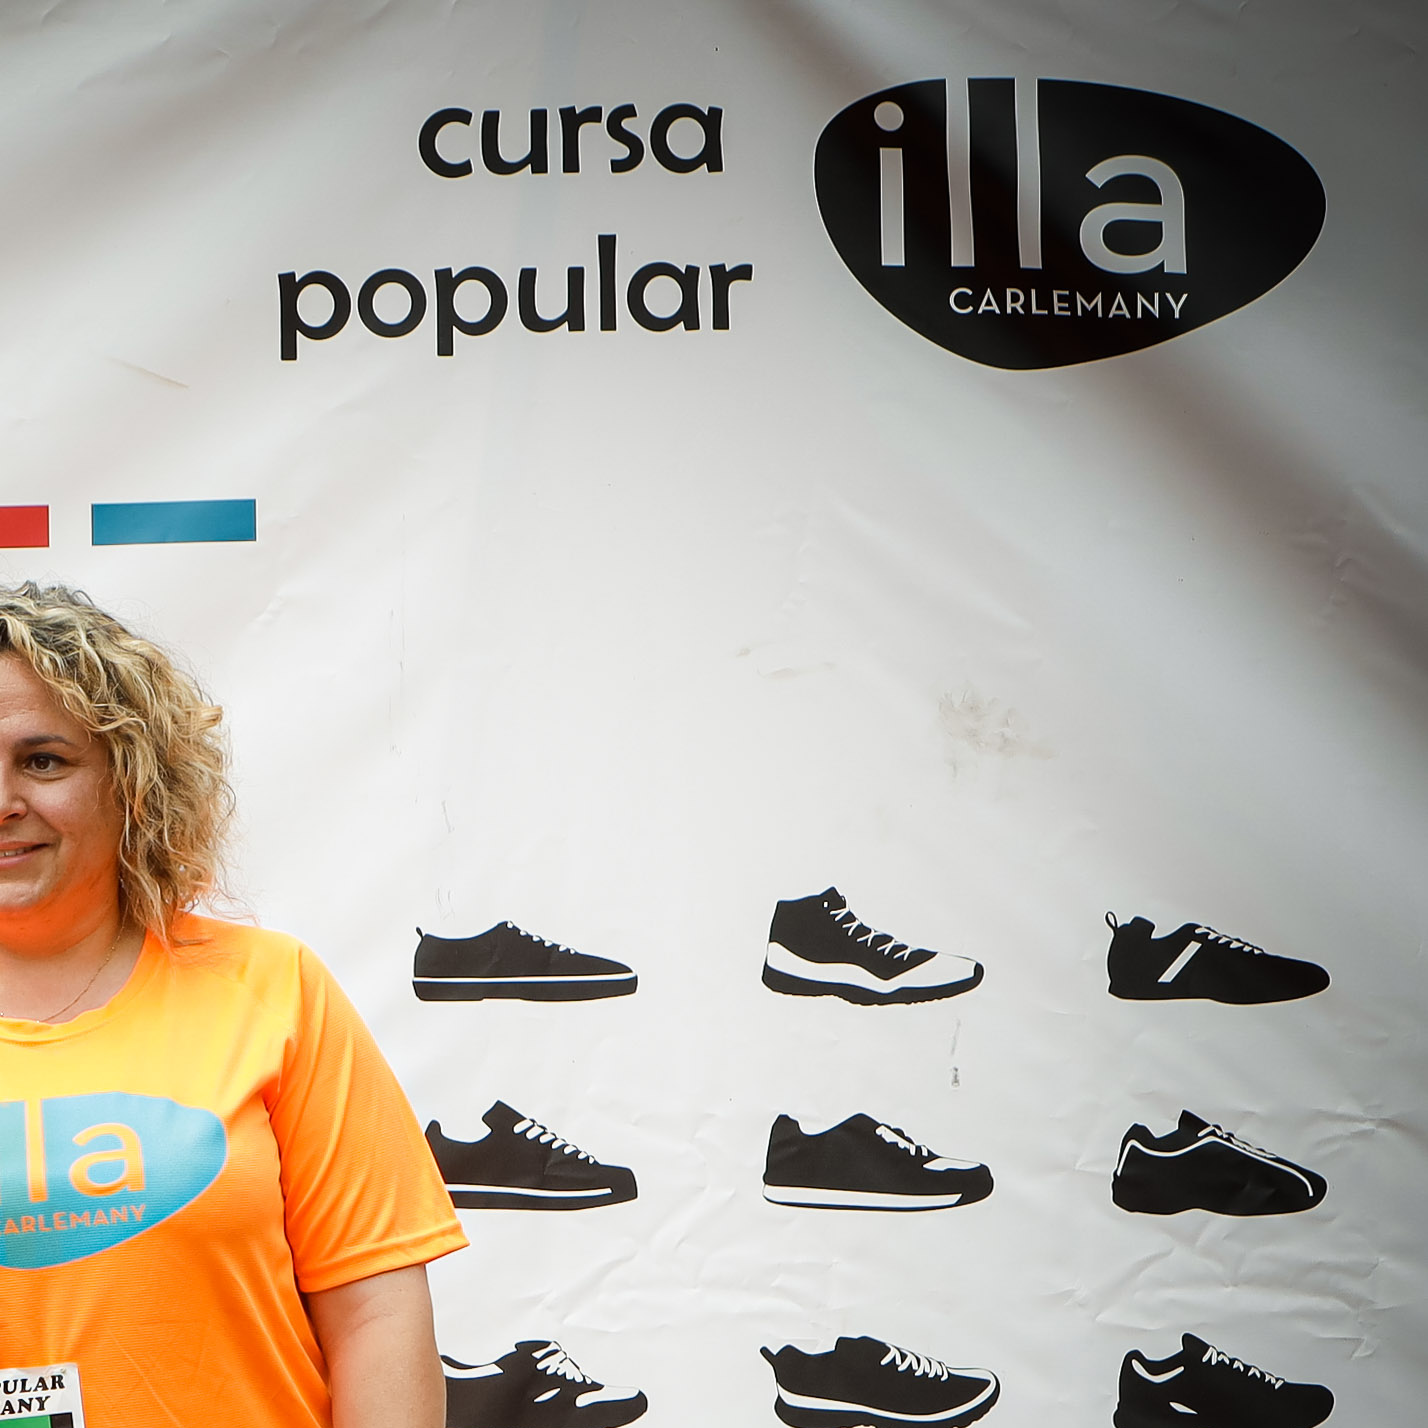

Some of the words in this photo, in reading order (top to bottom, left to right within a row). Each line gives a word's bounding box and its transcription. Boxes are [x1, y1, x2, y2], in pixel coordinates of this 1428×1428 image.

[417, 102, 724, 178] cursa
[876, 76, 1190, 276] illa
[278, 234, 754, 361] popular
[948, 286, 1190, 320] CARLEMANY
